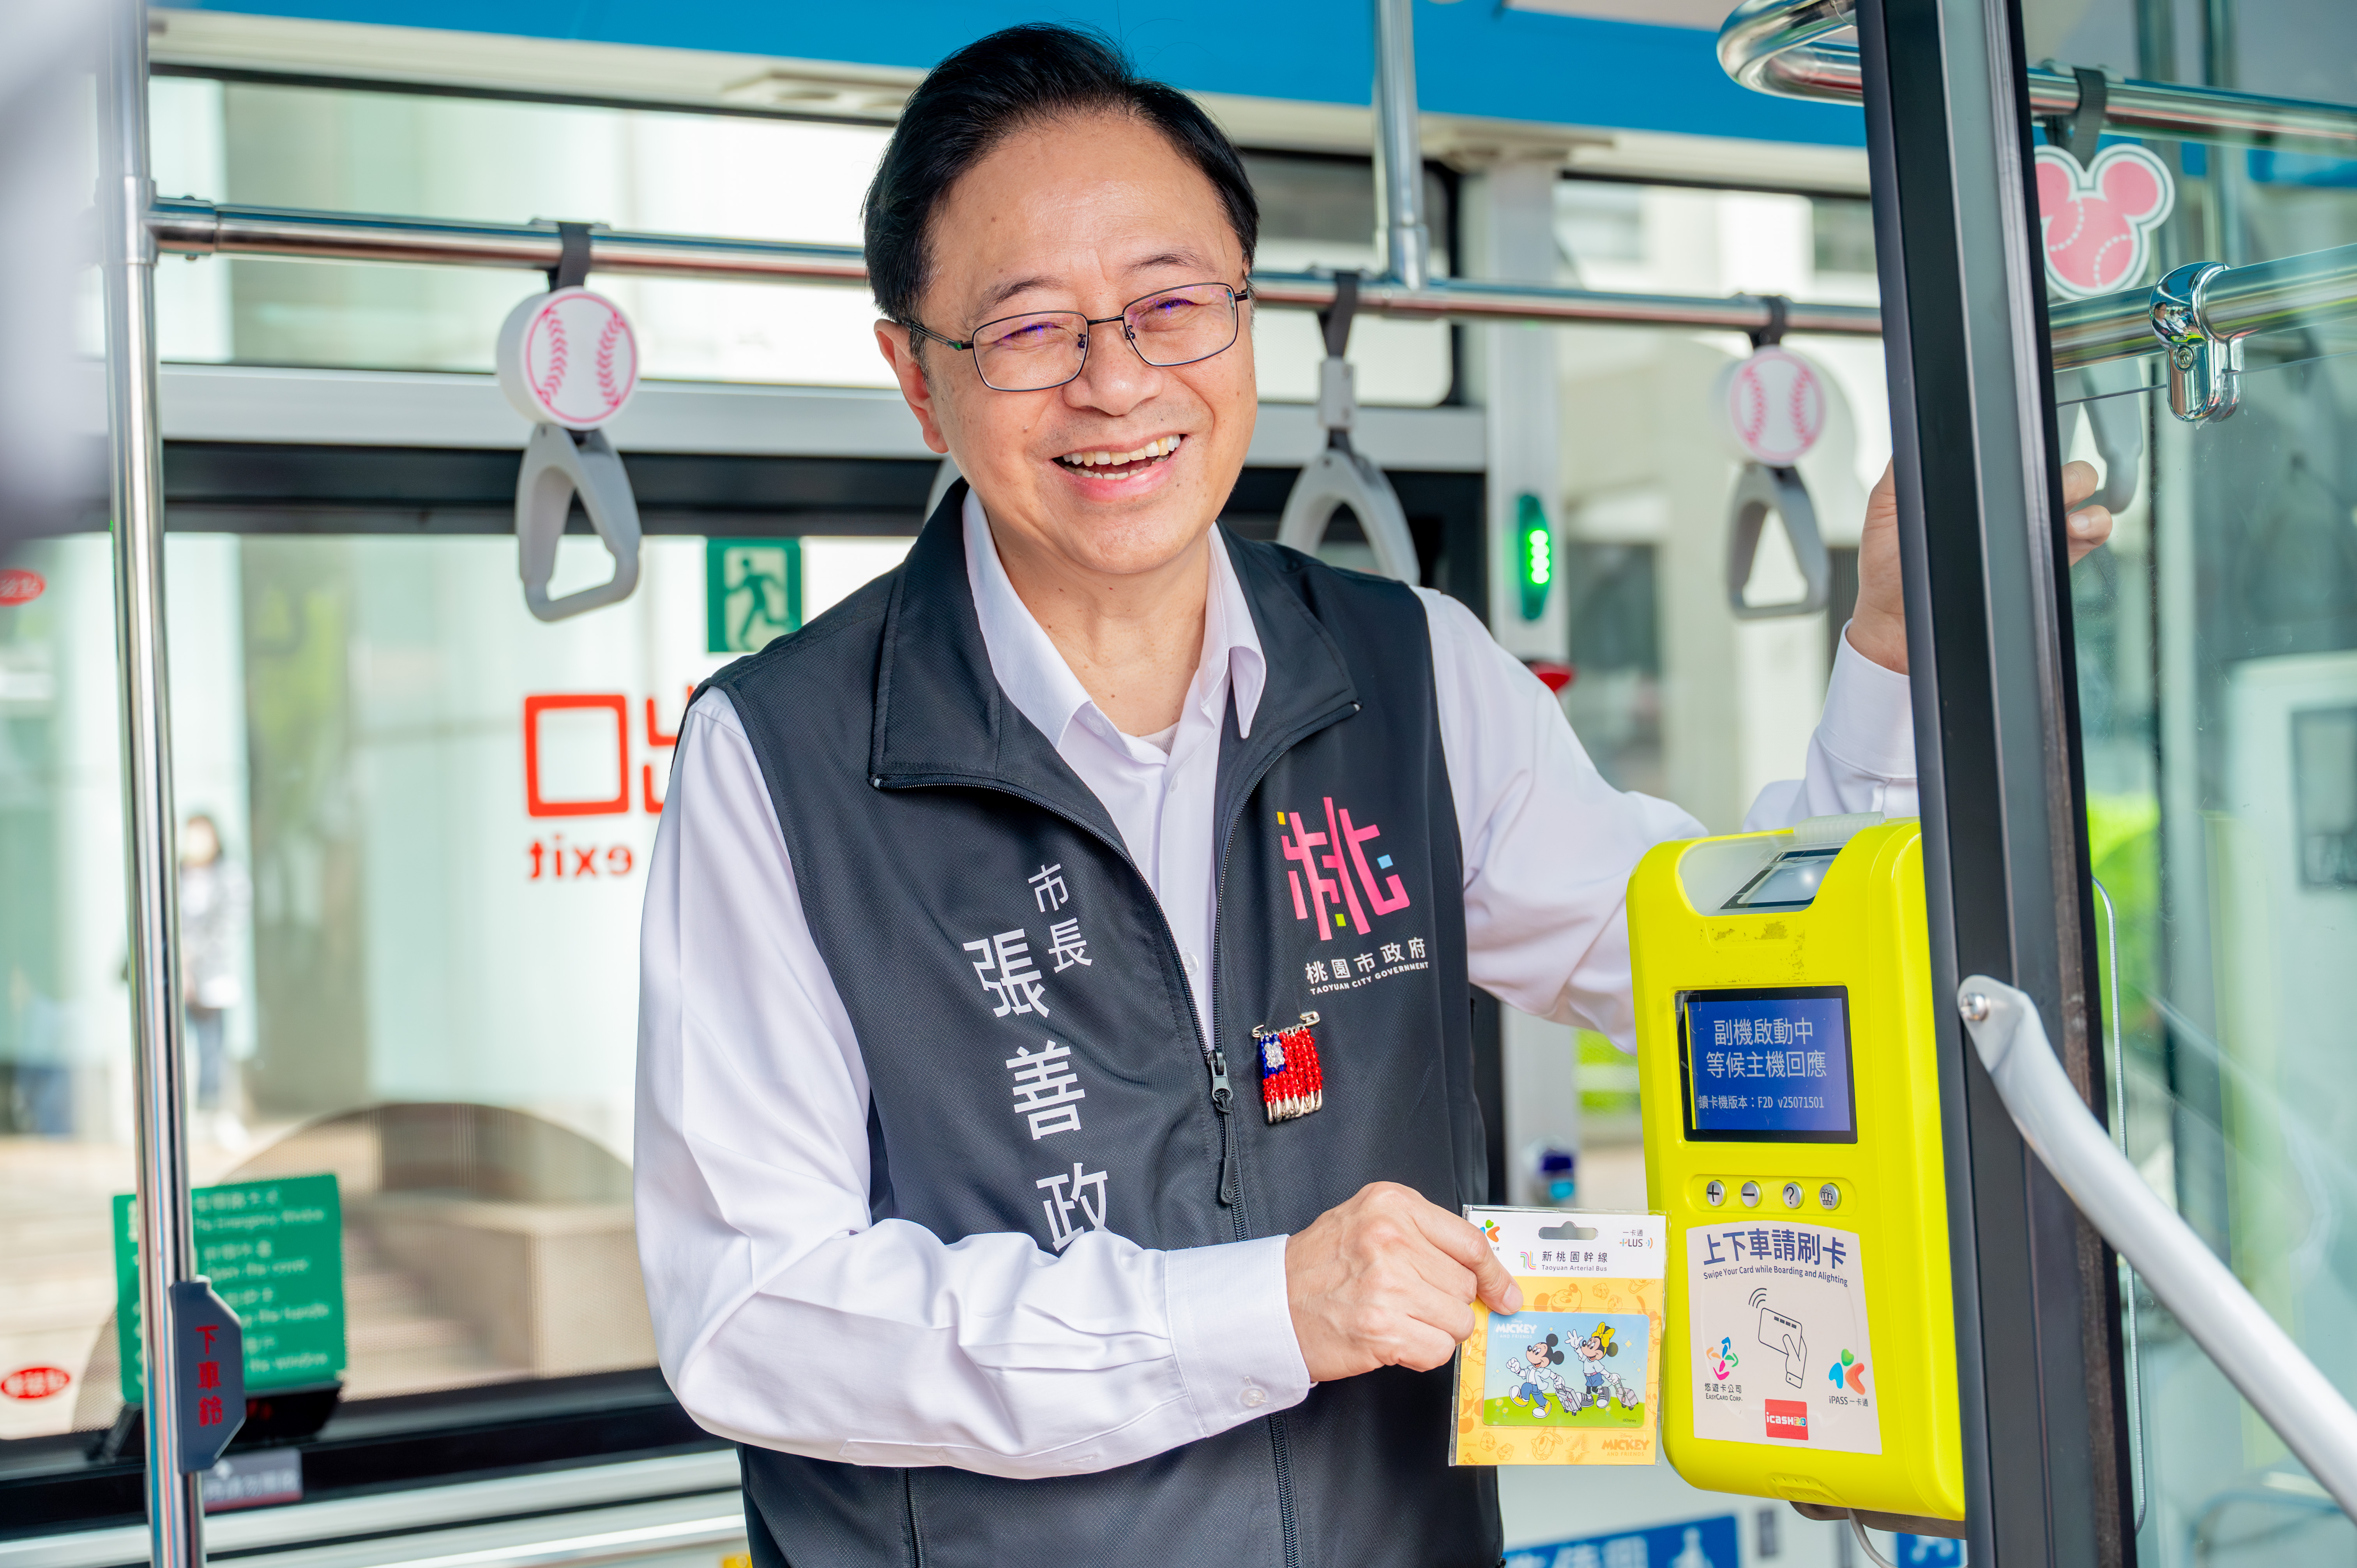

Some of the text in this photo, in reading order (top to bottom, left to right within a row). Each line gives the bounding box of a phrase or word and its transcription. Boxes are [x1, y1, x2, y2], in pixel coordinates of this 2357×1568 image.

[1028, 863, 1092, 973] 市長
[1305, 937, 1426, 984] 桃園市政府
[1310, 961, 1429, 995] TAOYUAN CITY GOVERNMENT
[1713, 1017, 1813, 1046] 副機啟動中
[1706, 1049, 1827, 1079] 等候主機回應
[963, 928, 1112, 1252] 張善政
[1777, 1096, 1825, 1109] v25071501
[1542, 1251, 1608, 1263] 新桃園幹線
[1703, 1228, 1846, 1269] 上下車請刷卡
[1703, 1265, 1848, 1287] Swipe Your Card while Boarding and Alighting
[1495, 1323, 1537, 1334] MICKEY
[195, 1324, 223, 1427] 下車鈴
[1705, 1383, 1742, 1393] 悠遊卡公司
[1829, 1396, 1868, 1407] iPASS 一卡通
[1601, 1439, 1650, 1450] MICKEY
